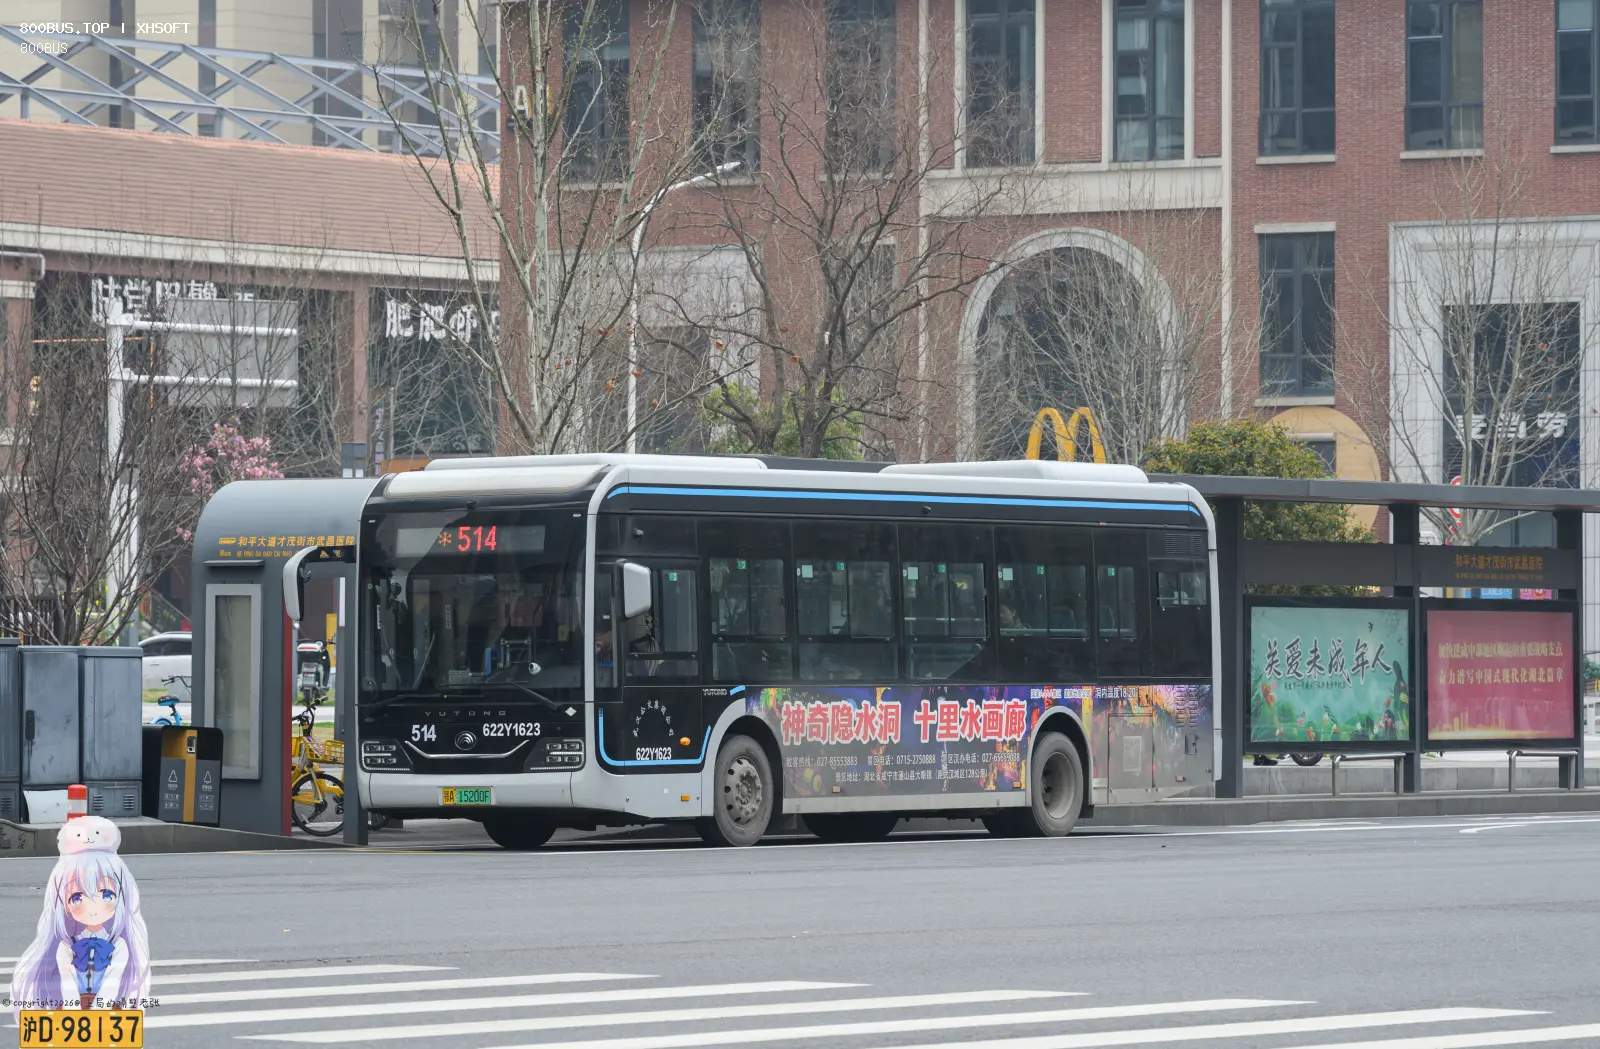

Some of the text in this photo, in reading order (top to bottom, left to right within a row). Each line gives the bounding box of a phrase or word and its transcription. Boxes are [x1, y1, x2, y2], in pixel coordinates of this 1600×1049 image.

[457, 525, 497, 552] 514
[782, 698, 1027, 745] 神奇隐水洞 十里水画廊
[411, 725, 437, 741] 514
[482, 723, 541, 737] 622Y1623
[635, 747, 672, 761] 622Y1623
